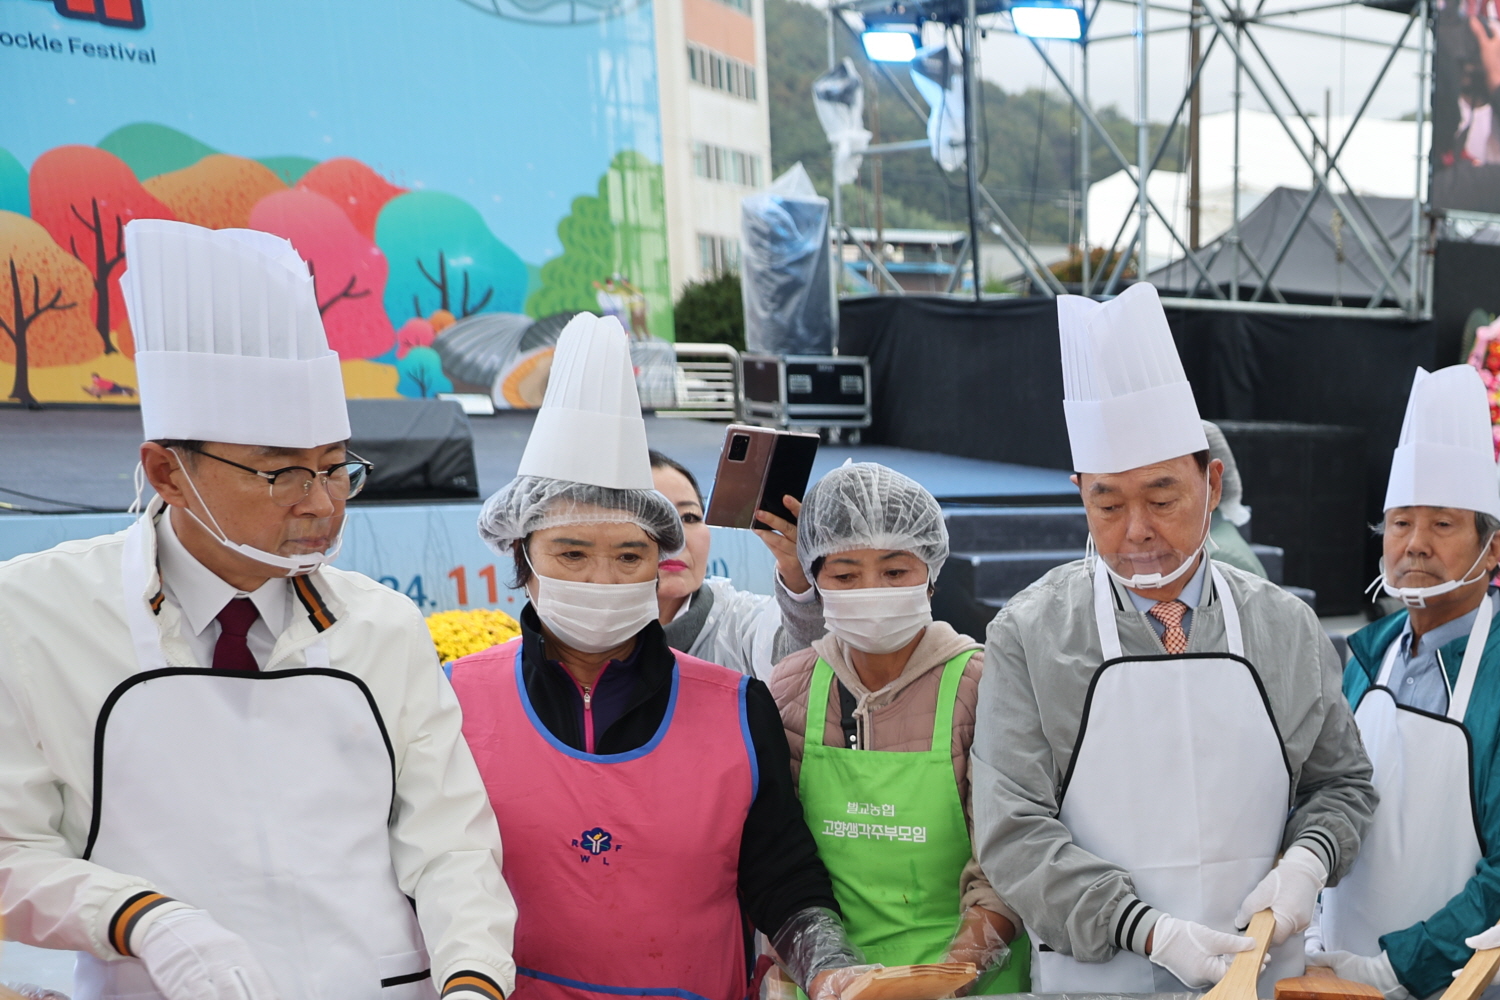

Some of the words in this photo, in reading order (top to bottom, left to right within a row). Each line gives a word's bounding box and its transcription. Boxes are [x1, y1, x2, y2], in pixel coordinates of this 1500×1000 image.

[0, 31, 63, 54] ockle
[68, 37, 156, 64] Festival
[448, 565, 514, 606] 11.
[846, 801, 895, 817] 벌교농협
[822, 819, 927, 843] 고향생각주부모임
[571, 839, 579, 848] R
[580, 854, 590, 863] W
[603, 857, 610, 866] L
